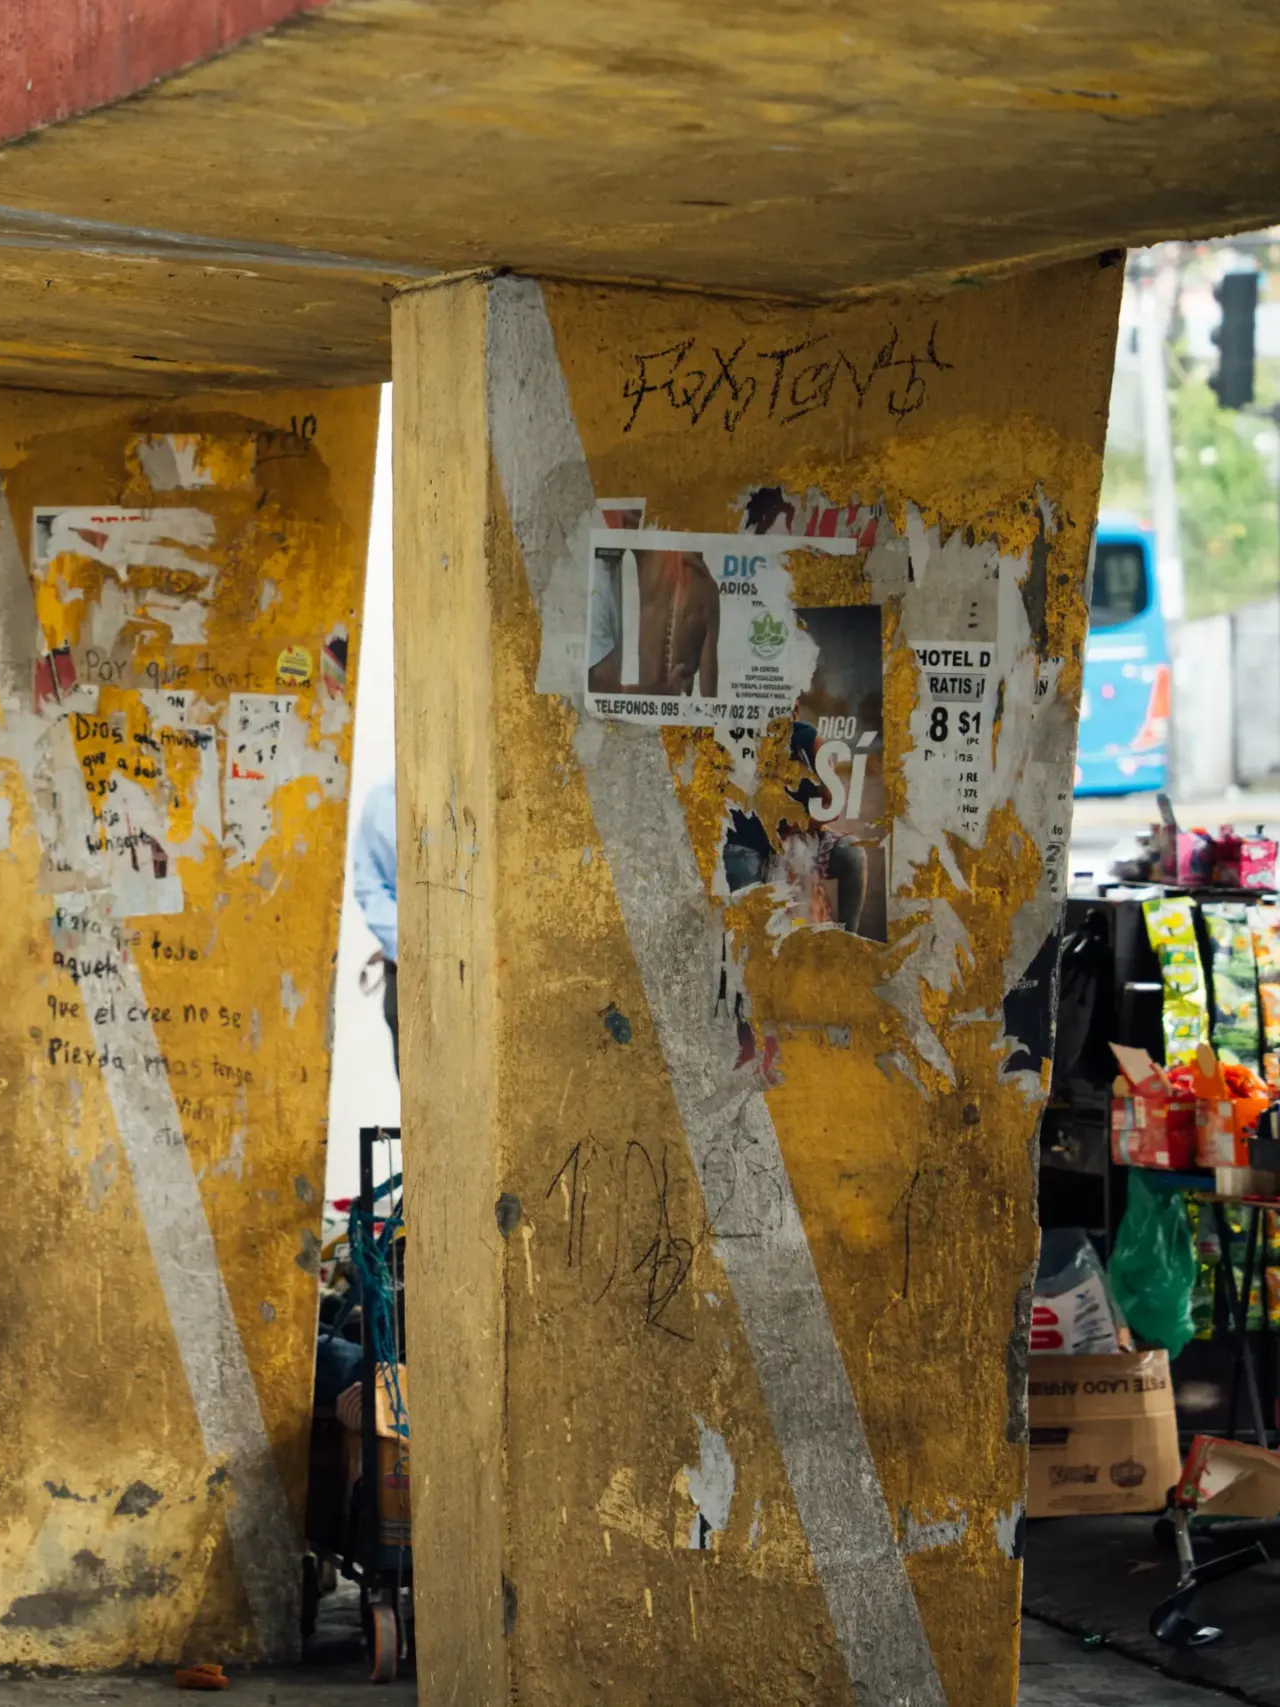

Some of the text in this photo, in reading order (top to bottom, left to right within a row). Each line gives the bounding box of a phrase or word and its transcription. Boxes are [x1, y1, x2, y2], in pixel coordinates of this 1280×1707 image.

[916, 649, 973, 667] HOTEL
[595, 699, 658, 716] TELEFONOS:
[661, 702, 680, 716] 095
[76, 712, 123, 743] Dios
[817, 716, 857, 740] DIGO
[930, 706, 949, 742] 8
[808, 730, 878, 822] SÍ
[55, 907, 102, 934] Para
[151, 930, 198, 961] todo
[47, 995, 80, 1021] que
[127, 1005, 172, 1023] cree
[183, 1003, 210, 1023] no
[219, 1006, 242, 1029] se
[48, 1037, 125, 1072] Pierda
[1083, 1378, 1130, 1395] LADO
